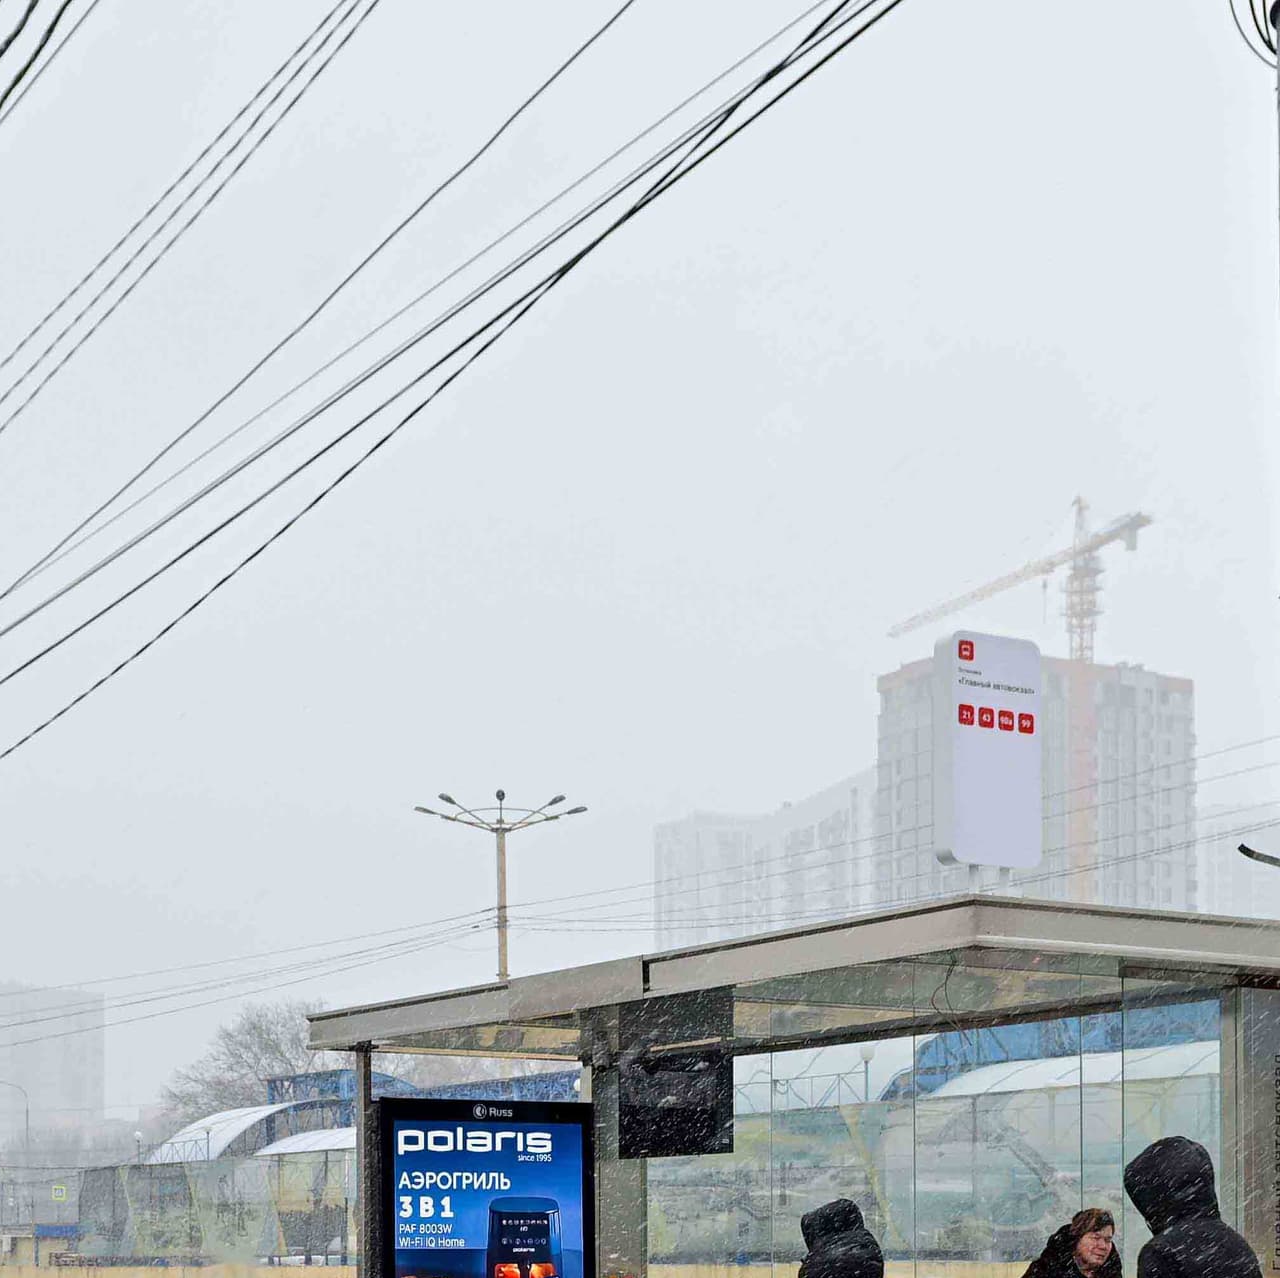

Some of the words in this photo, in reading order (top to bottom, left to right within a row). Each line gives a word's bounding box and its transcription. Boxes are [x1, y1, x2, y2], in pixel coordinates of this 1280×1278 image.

[489, 1107, 513, 1117] Russ
[397, 1126, 552, 1155] polaris
[517, 1154, 535, 1162] since
[536, 1153, 552, 1162] 1995
[399, 1171, 511, 1190] АЭРОГРИЛЬ
[399, 1195, 413, 1218] 3
[440, 1195, 454, 1218] 1
[399, 1223, 417, 1234] PAF
[419, 1223, 453, 1234] 8003W
[438, 1237, 465, 1247] Home
